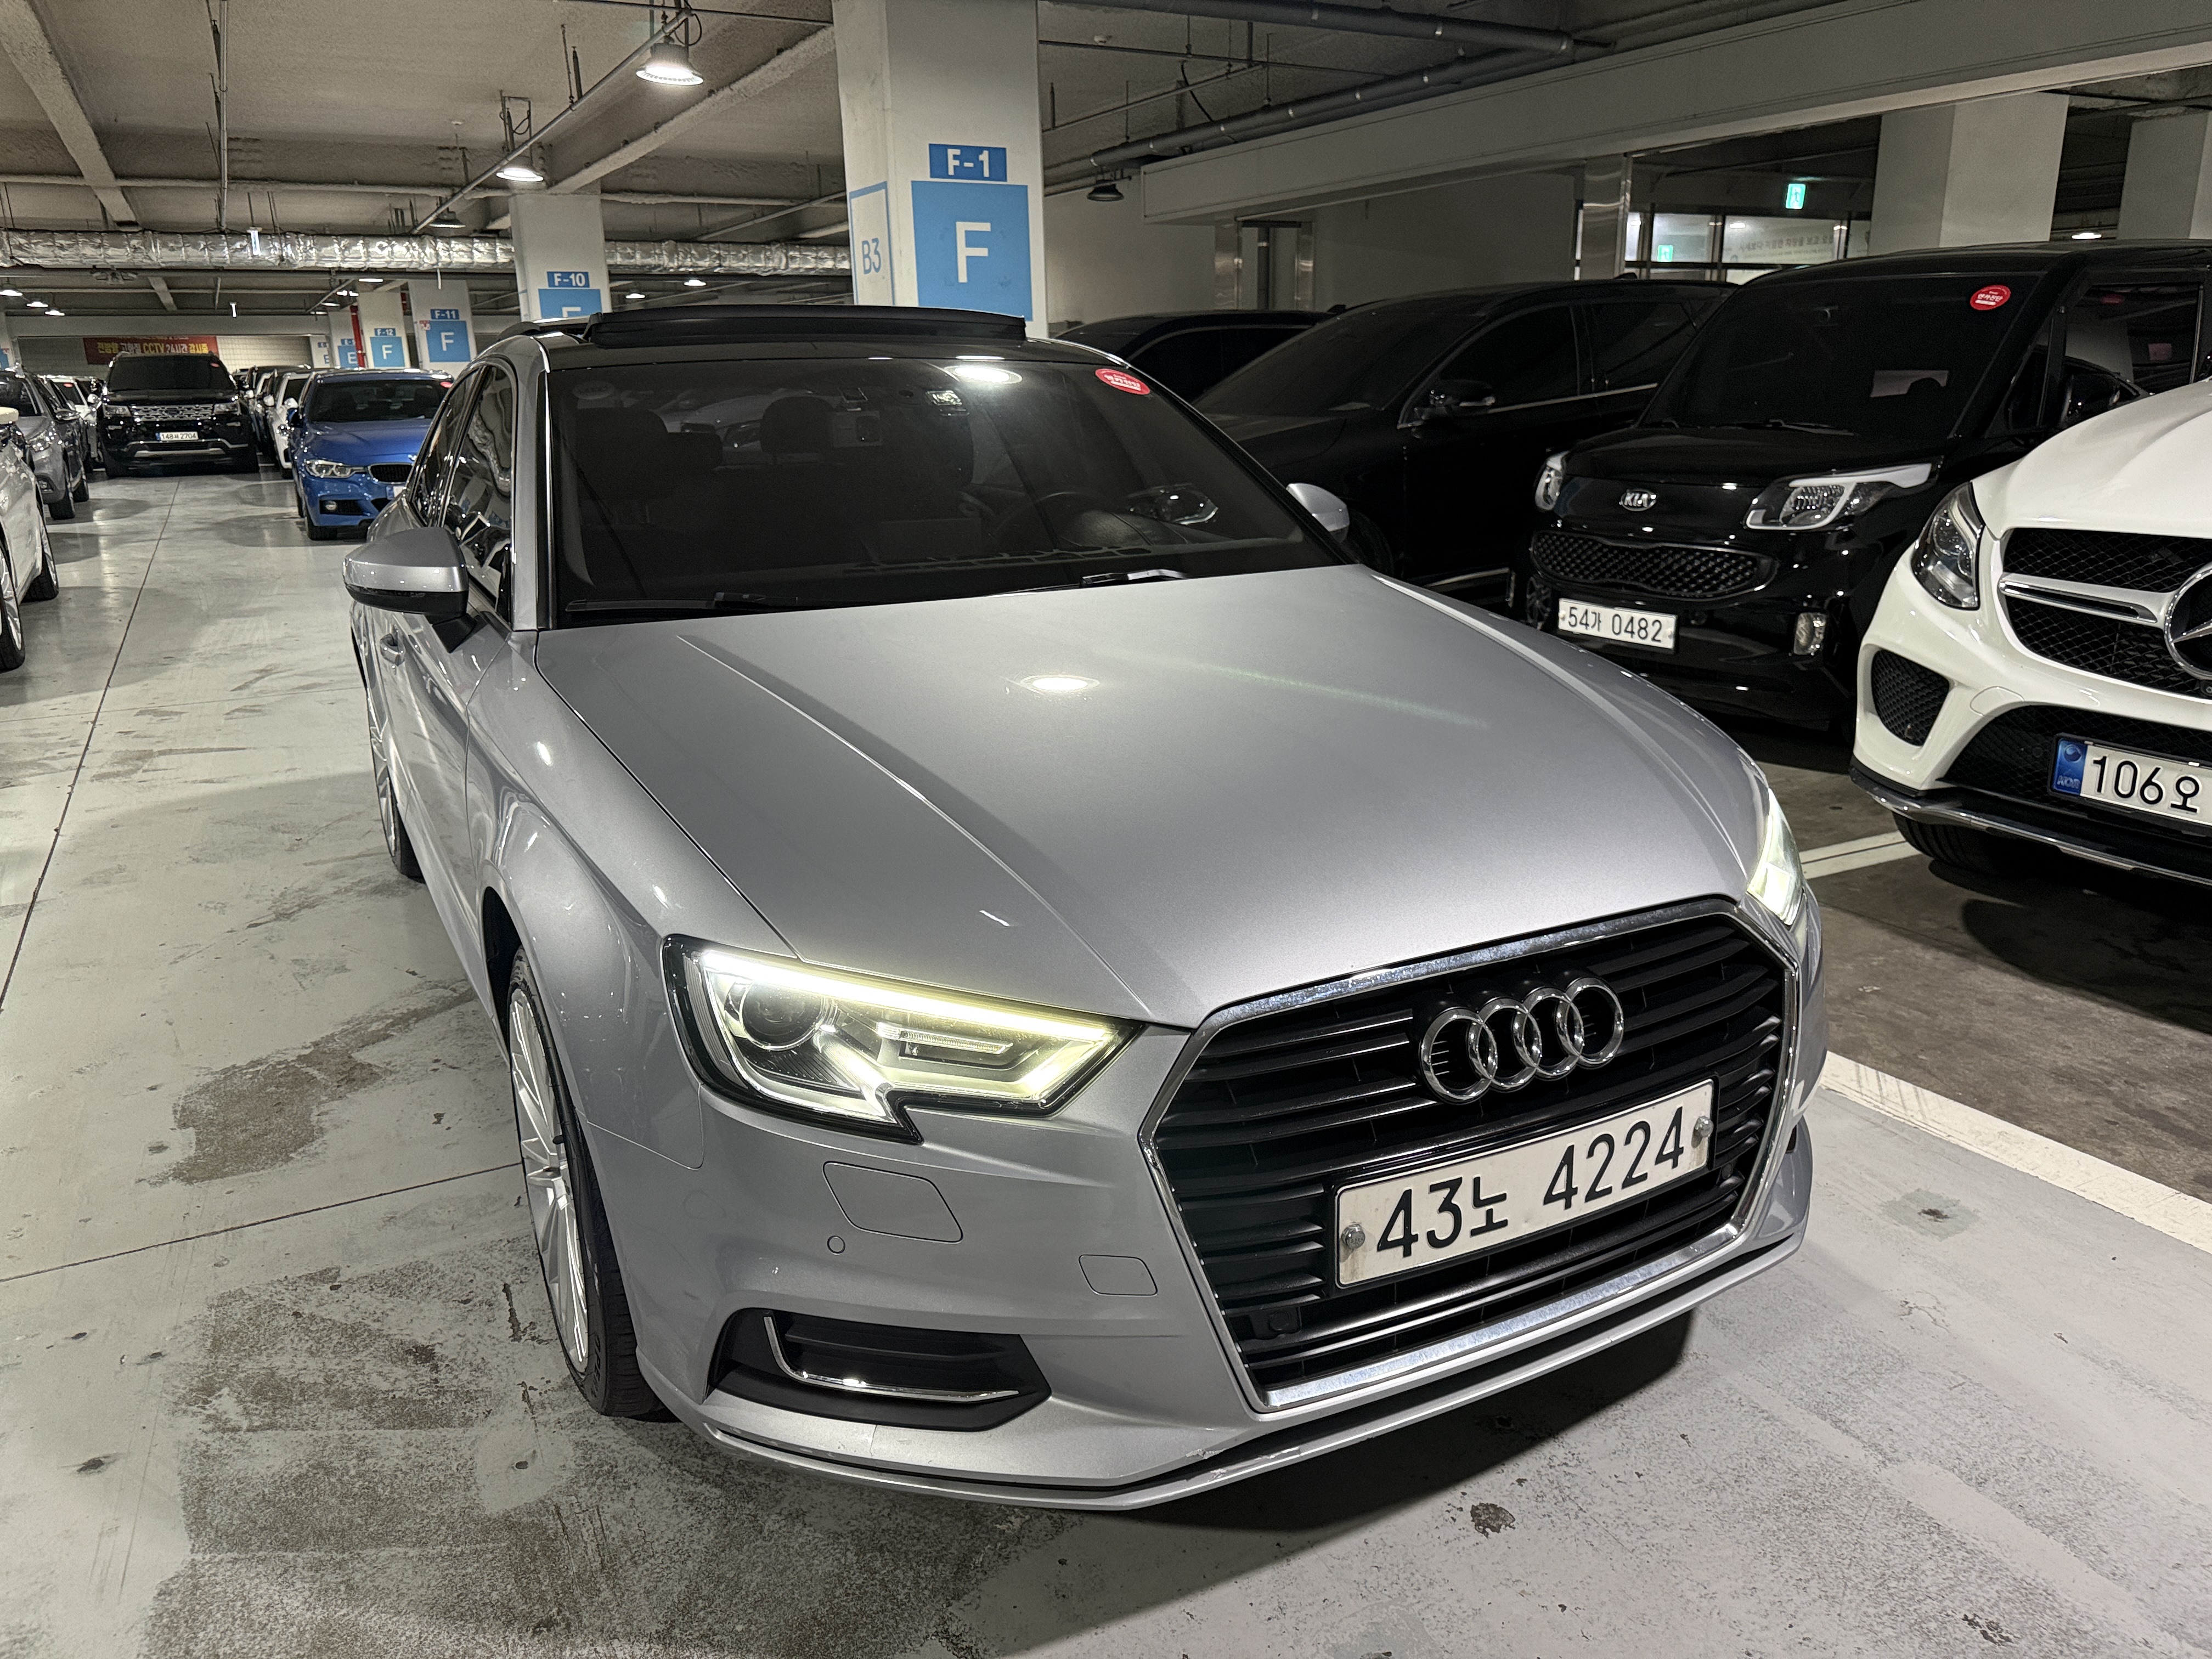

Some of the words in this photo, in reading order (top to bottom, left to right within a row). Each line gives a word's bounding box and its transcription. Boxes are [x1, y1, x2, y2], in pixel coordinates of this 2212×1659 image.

[947, 149, 990, 178] F-1
[861, 238, 882, 275] B3
[956, 221, 991, 283] F
[554, 273, 585, 286] F-10
[435, 310, 456, 319] F-11
[143, 342, 164, 354] CCTV
[382, 345, 393, 360] F
[441, 332, 454, 351] F
[1624, 493, 1649, 507] KIA
[1568, 606, 1601, 632] 54가
[1611, 613, 1662, 643] 0482
[2092, 755, 2199, 813] 106오
[1376, 1175, 1509, 1259] 43노
[1542, 1105, 1685, 1211] 4224
